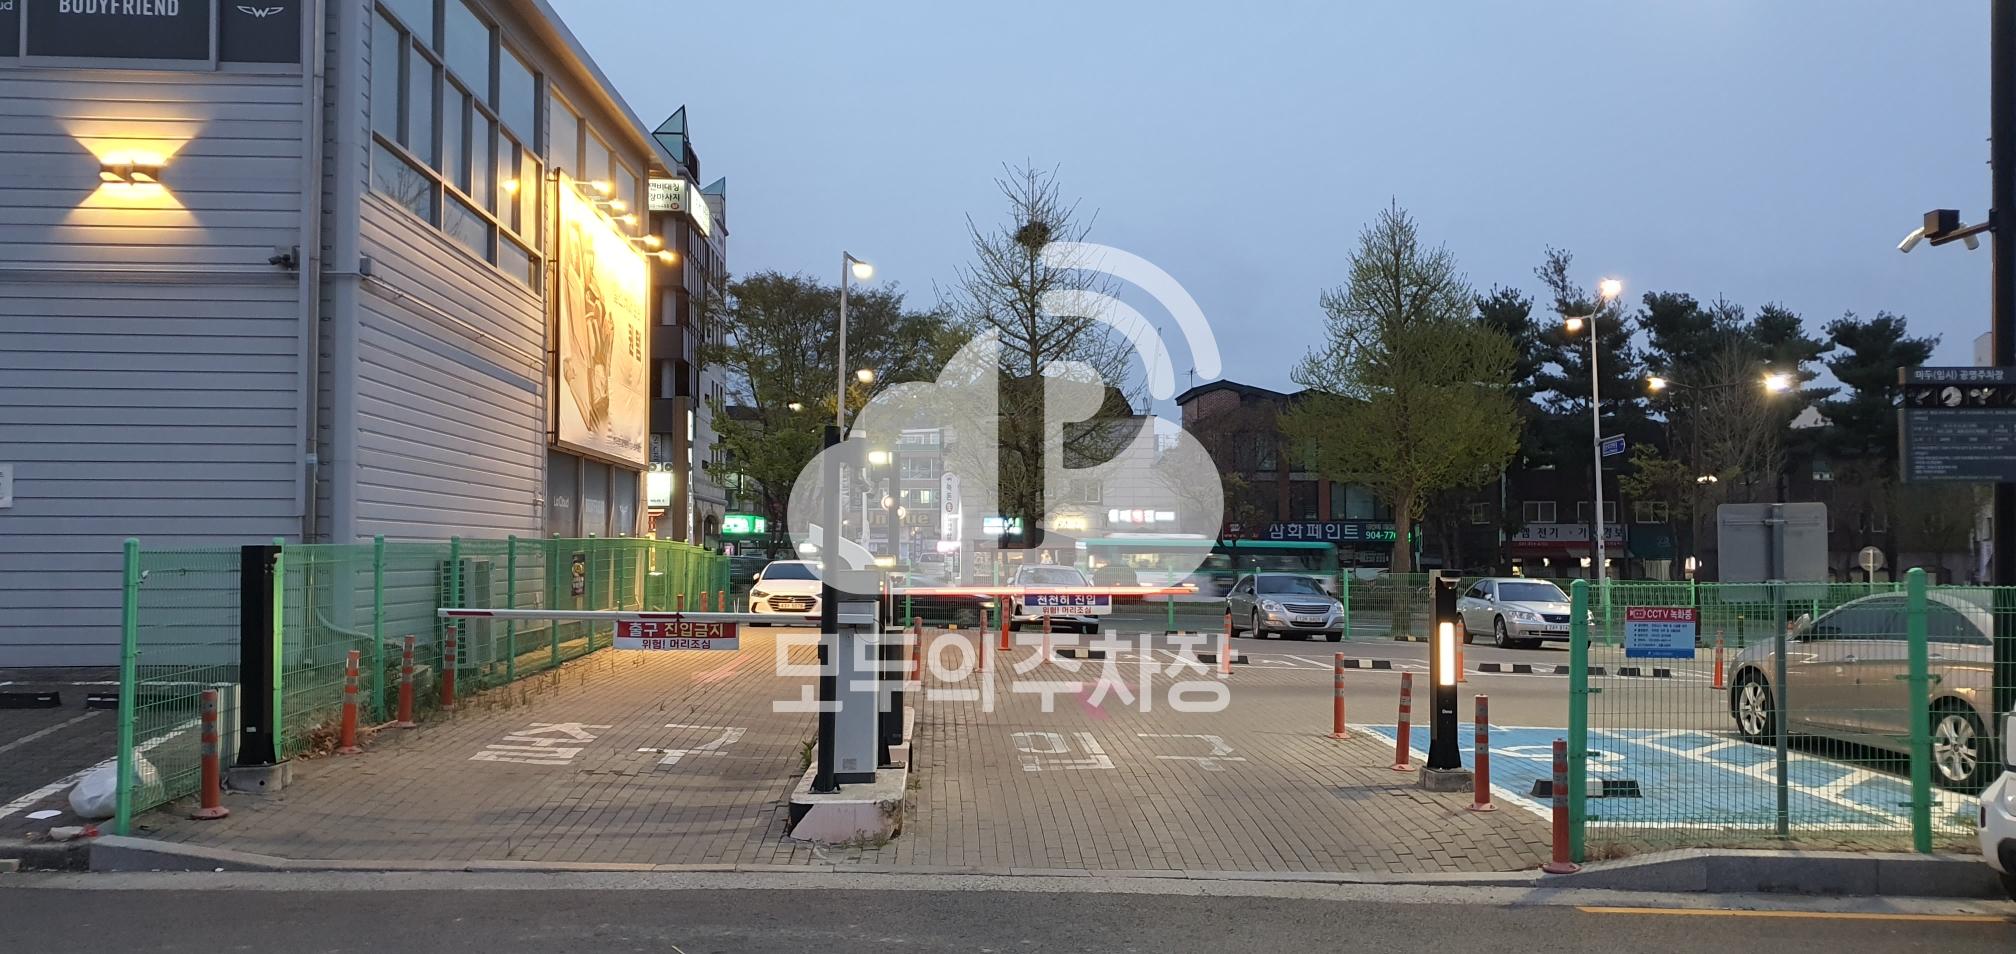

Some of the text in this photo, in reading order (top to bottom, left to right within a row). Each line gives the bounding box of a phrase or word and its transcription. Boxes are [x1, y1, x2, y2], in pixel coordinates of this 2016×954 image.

[59, 0, 179, 16] BODYFRIEND
[1269, 523, 1359, 540] 삼화페인트
[1537, 527, 1559, 539] 전기
[1075, 595, 1096, 606] 진입
[1061, 606, 1092, 615] 머리조심
[1647, 609, 1692, 620] CCTV 녹화중
[629, 622, 724, 638] 출구 진입금지
[641, 639, 711, 650] 위험! 머리조심
